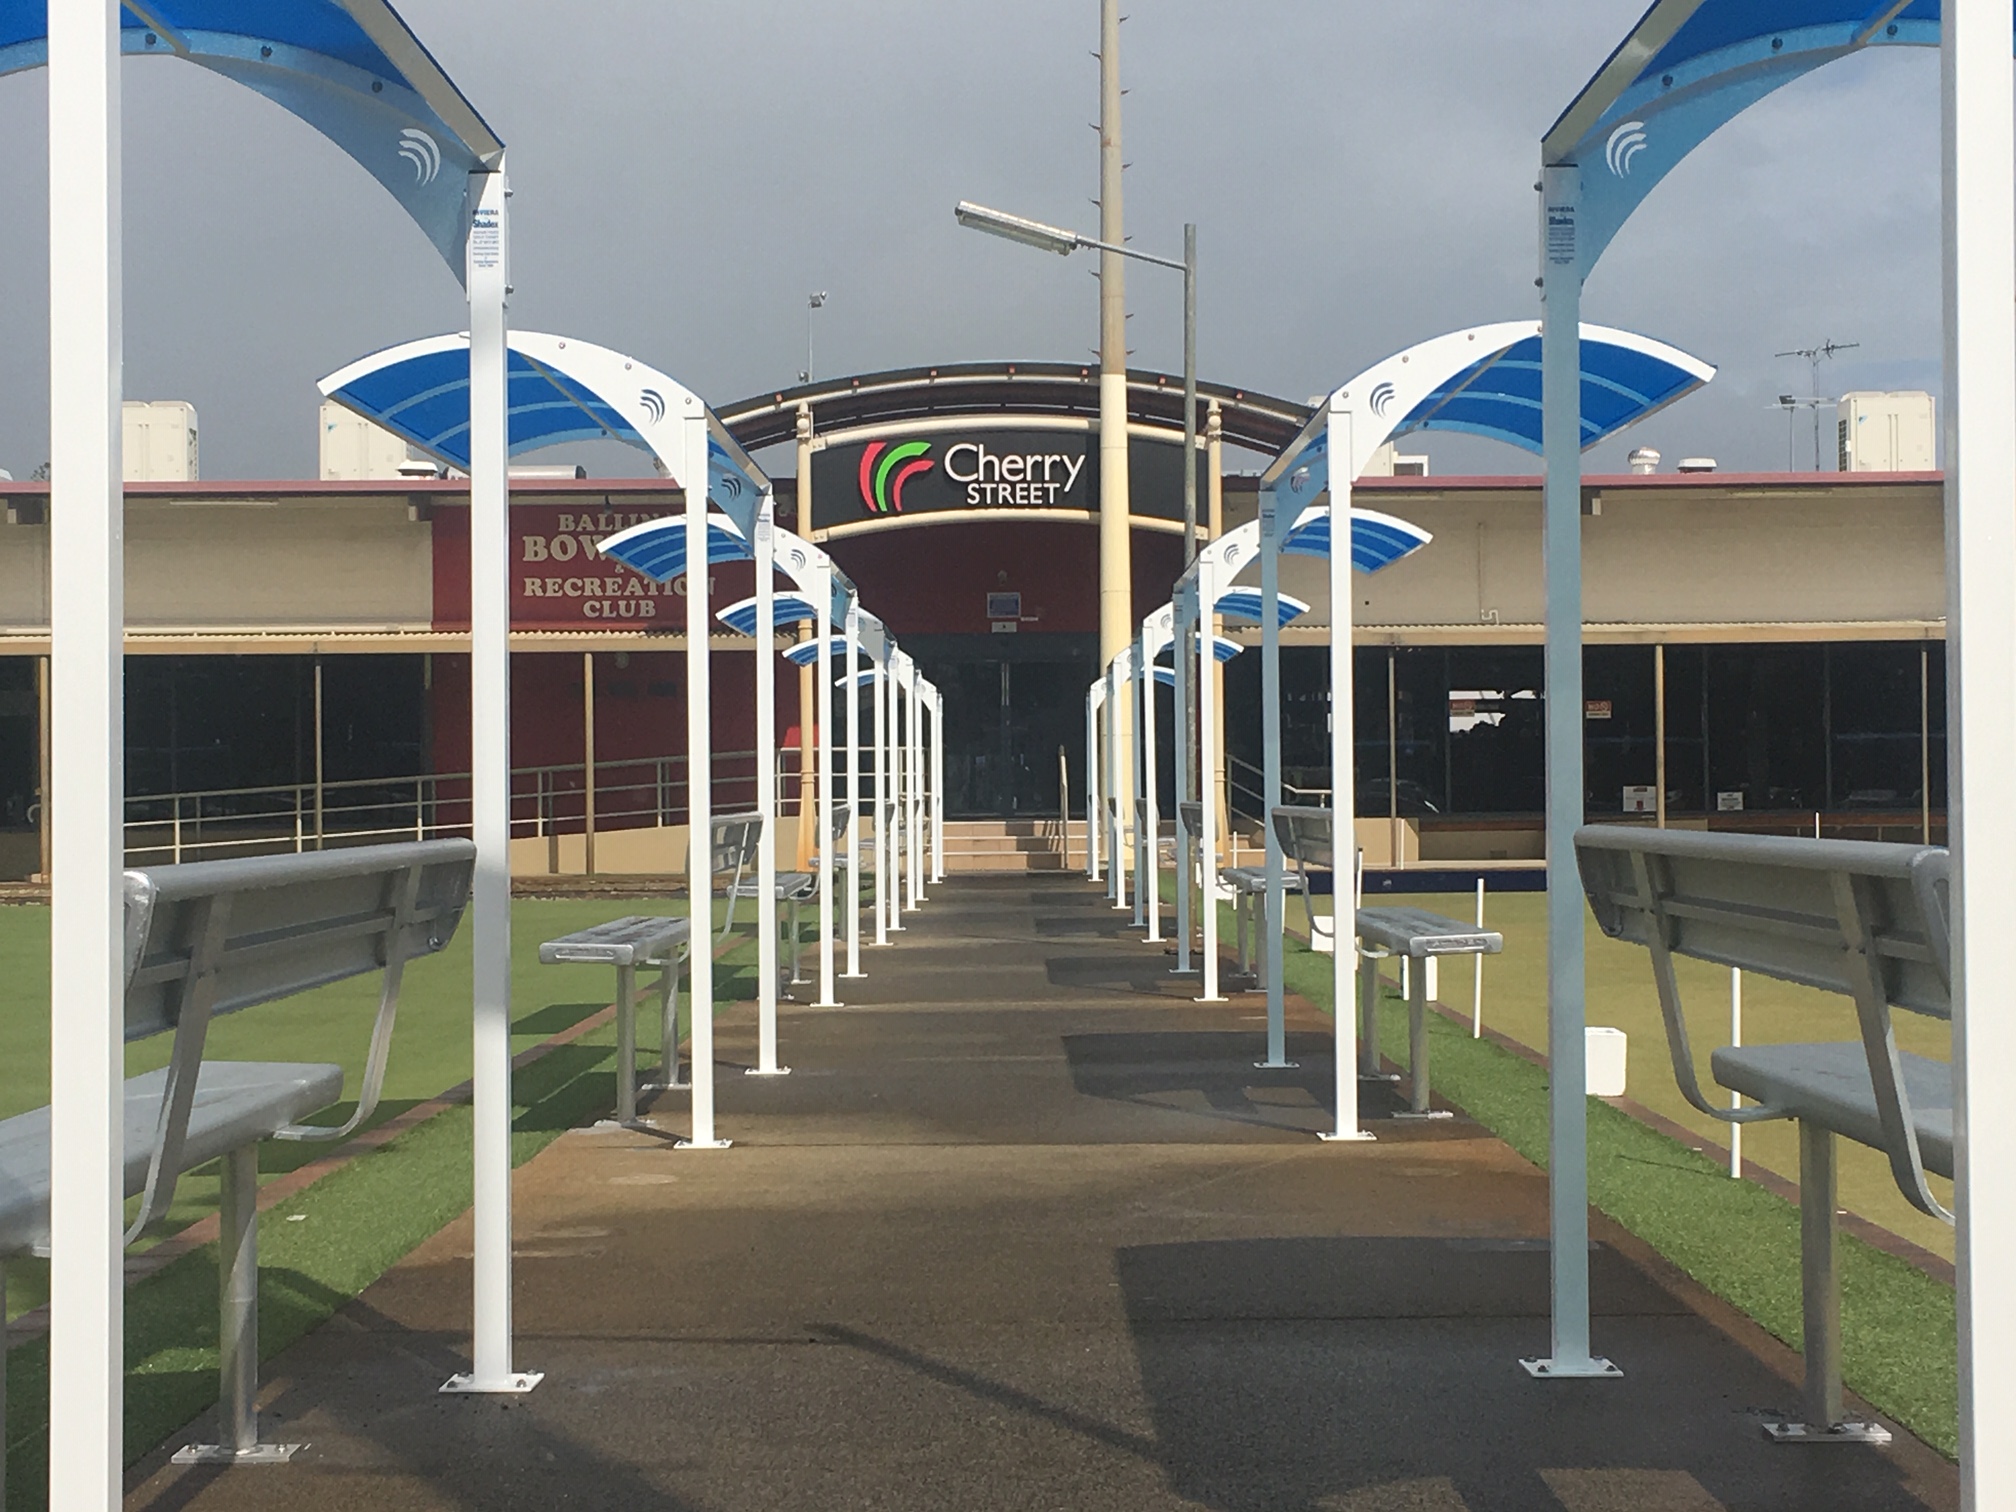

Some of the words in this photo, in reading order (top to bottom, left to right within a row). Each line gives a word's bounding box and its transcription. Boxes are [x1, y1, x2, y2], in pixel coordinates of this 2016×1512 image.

[944, 443, 1086, 493] Cherry
[967, 483, 1061, 505] STREET
[583, 600, 656, 617] CLUB
